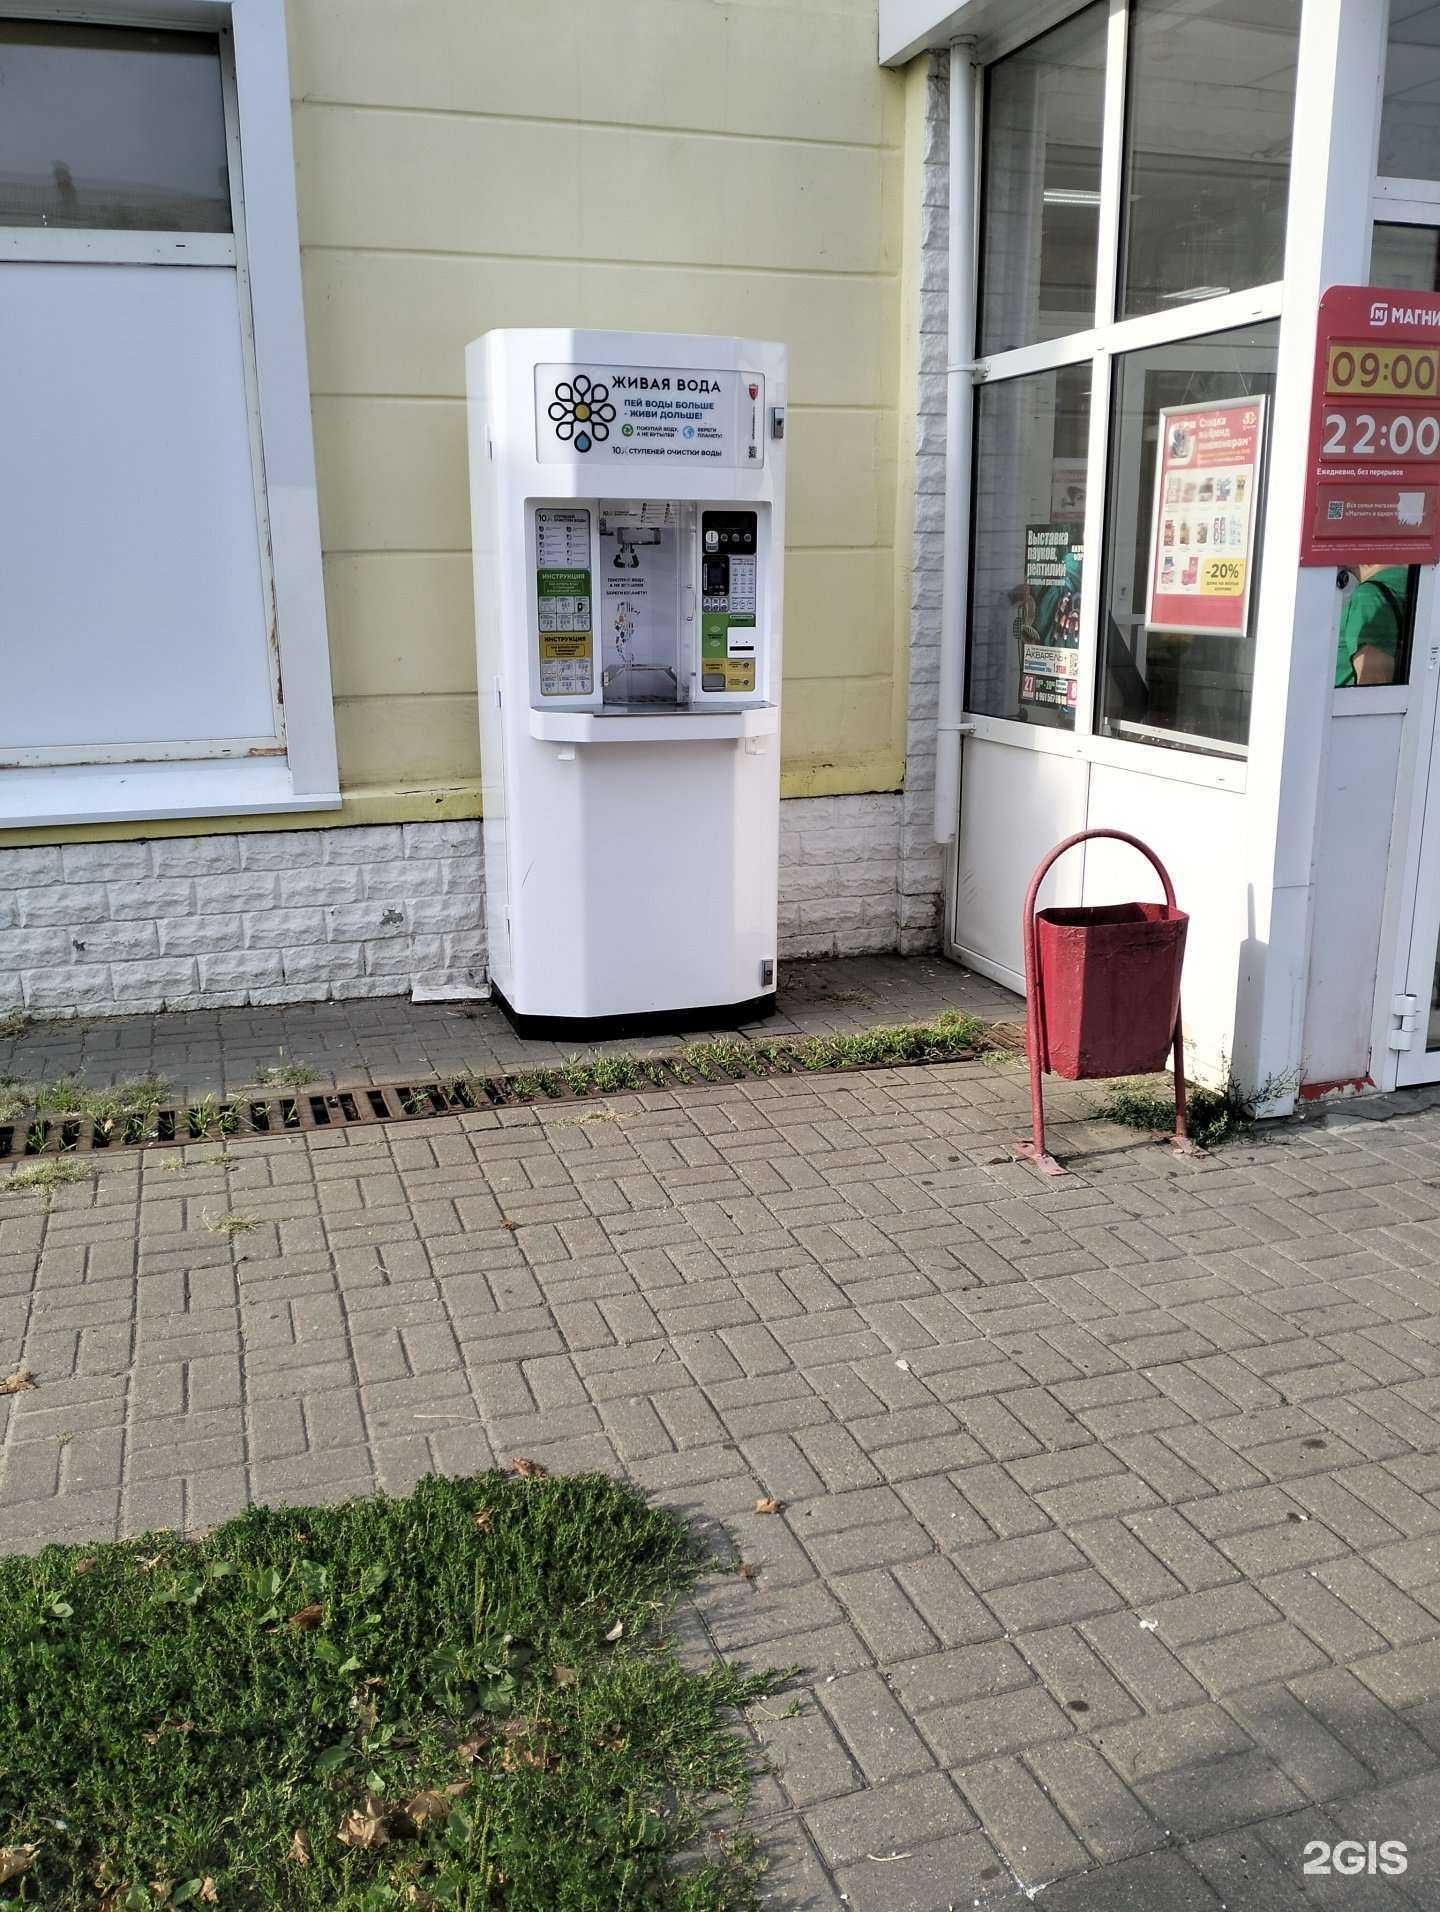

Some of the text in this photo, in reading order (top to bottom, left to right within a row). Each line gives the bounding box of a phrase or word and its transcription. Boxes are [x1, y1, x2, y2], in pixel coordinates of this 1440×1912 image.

[1391, 307, 1440, 326] МАГНИ
[1332, 351, 1435, 390] 09:00
[611, 375, 721, 394] ЖИВАЯ ВОДА
[624, 398, 715, 410] ПЕЙ ВОДЫ БОЛЬШЕ
[630, 409, 658, 418] ЖИВИ
[659, 410, 703, 420] ДОЛЬШЕ!
[1323, 414, 1440, 455] 22:00
[628, 447, 665, 455] СТУПЕНЕЙ
[666, 448, 700, 456] ОЧИСТКИ
[701, 449, 722, 457] ВОДЫ
[1316, 467, 1404, 477] Ежедневно, без перерывов
[1028, 530, 1069, 546] Выставка
[1027, 547, 1058, 562] пауков,
[1027, 560, 1067, 577] рептилий
[1205, 563, 1239, 579] -20%
[1024, 676, 1034, 692] 27
